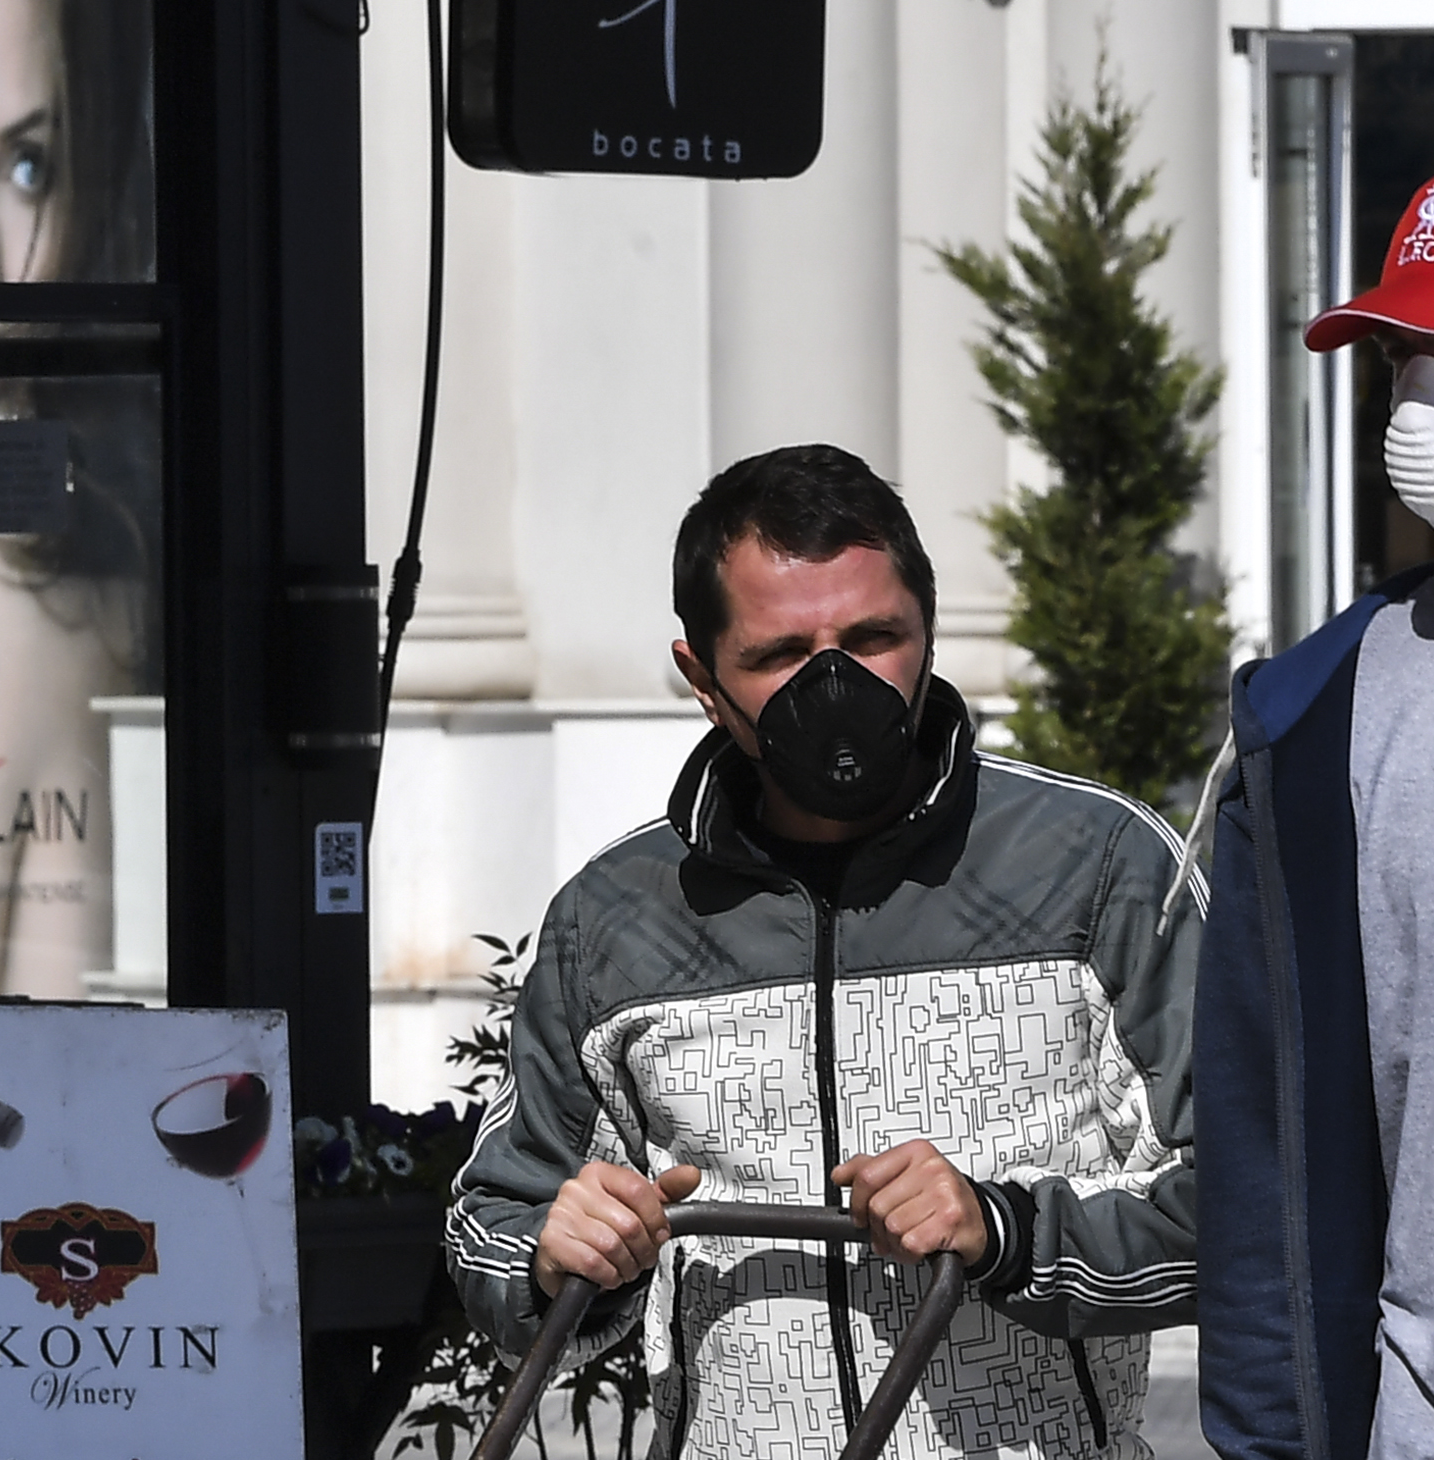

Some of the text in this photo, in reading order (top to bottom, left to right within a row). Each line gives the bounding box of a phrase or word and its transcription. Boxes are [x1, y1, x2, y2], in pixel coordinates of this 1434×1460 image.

[592, 129, 741, 164] bocata
[59, 1237, 100, 1282] S
[30, 1366, 137, 1411] Winery
